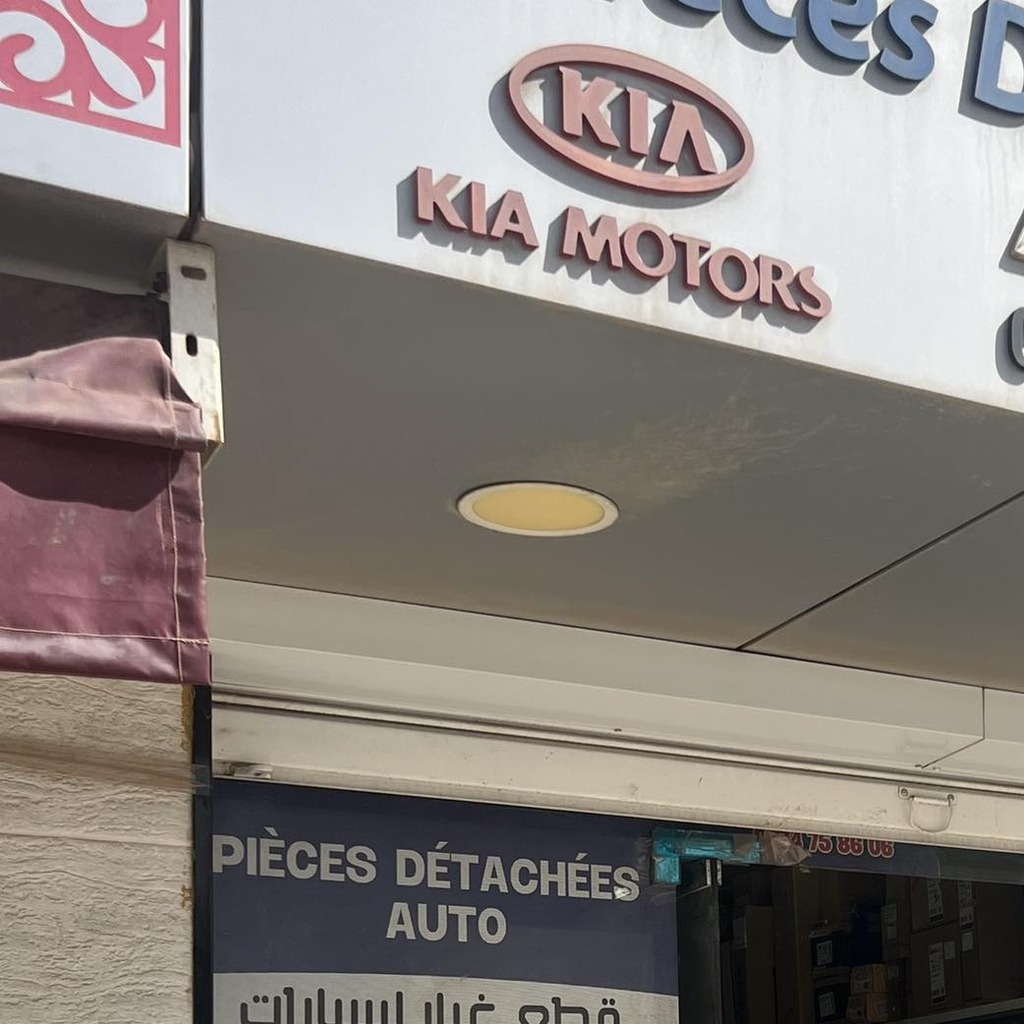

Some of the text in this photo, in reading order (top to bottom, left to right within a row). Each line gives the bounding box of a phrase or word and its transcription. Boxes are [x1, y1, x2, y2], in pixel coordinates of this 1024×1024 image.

[557, 65, 719, 175] KIA
[416, 166, 832, 318] KIA MOTORS
[212, 826, 641, 902] PIÈCES DÉTACHÉES
[386, 902, 507, 944] AUTO
